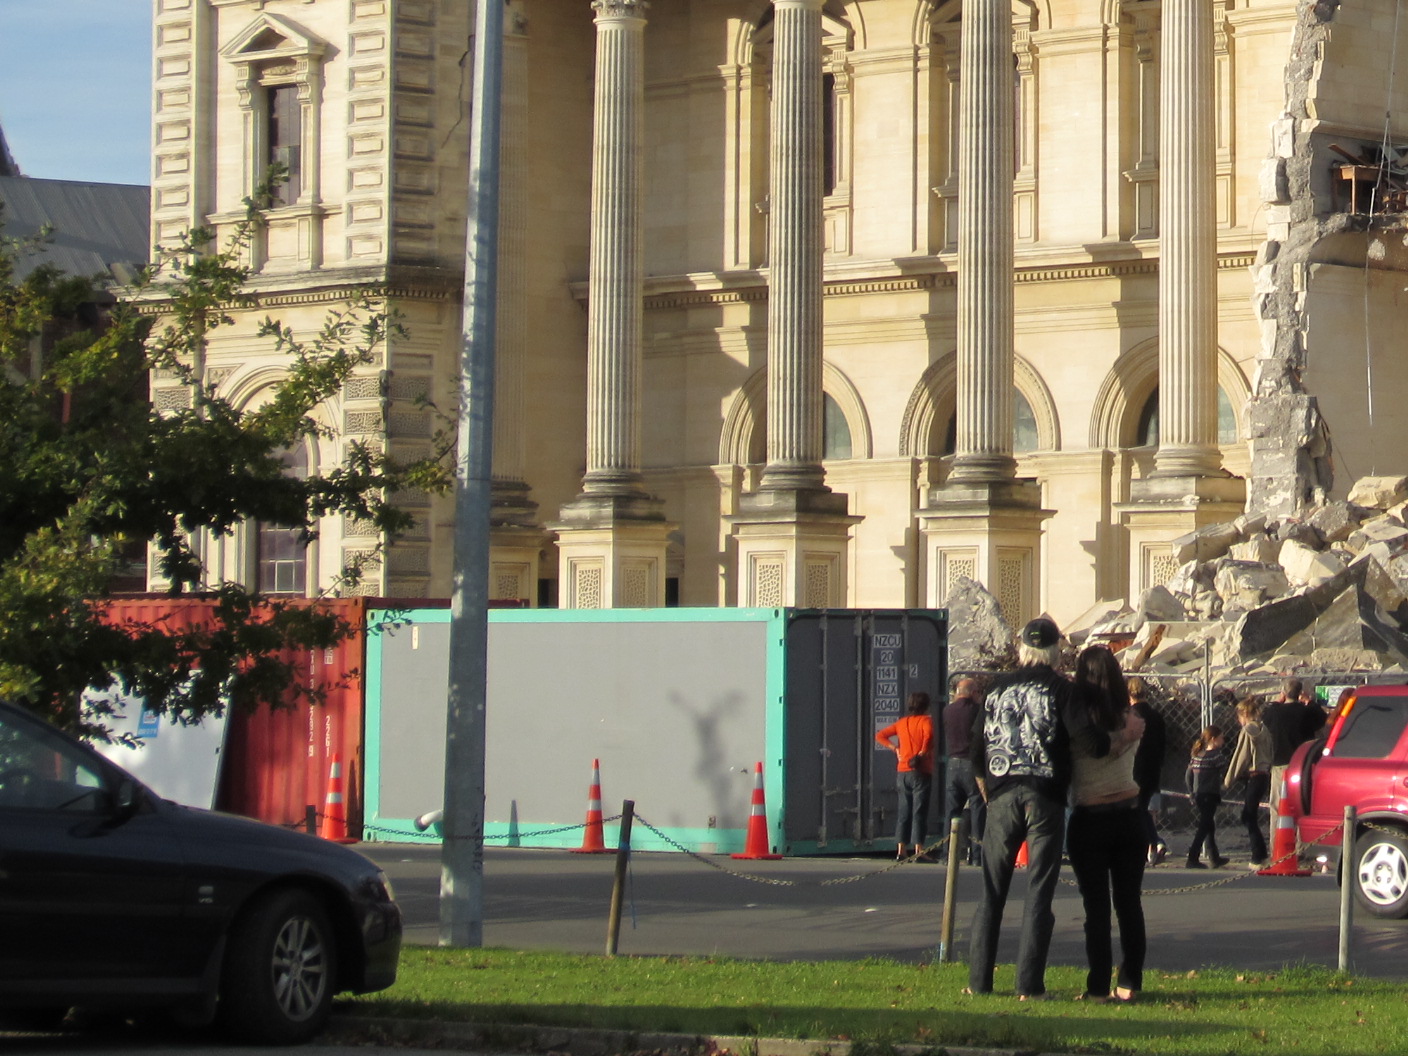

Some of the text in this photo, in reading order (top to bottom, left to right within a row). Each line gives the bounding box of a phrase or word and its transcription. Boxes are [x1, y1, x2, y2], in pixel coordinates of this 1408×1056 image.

[875, 635, 901, 647] NZCU
[881, 650, 894, 663] 20
[877, 667, 897, 679] 1141
[910, 665, 917, 677] 2
[877, 683, 897, 695] NZX
[875, 699, 899, 711] 2040
